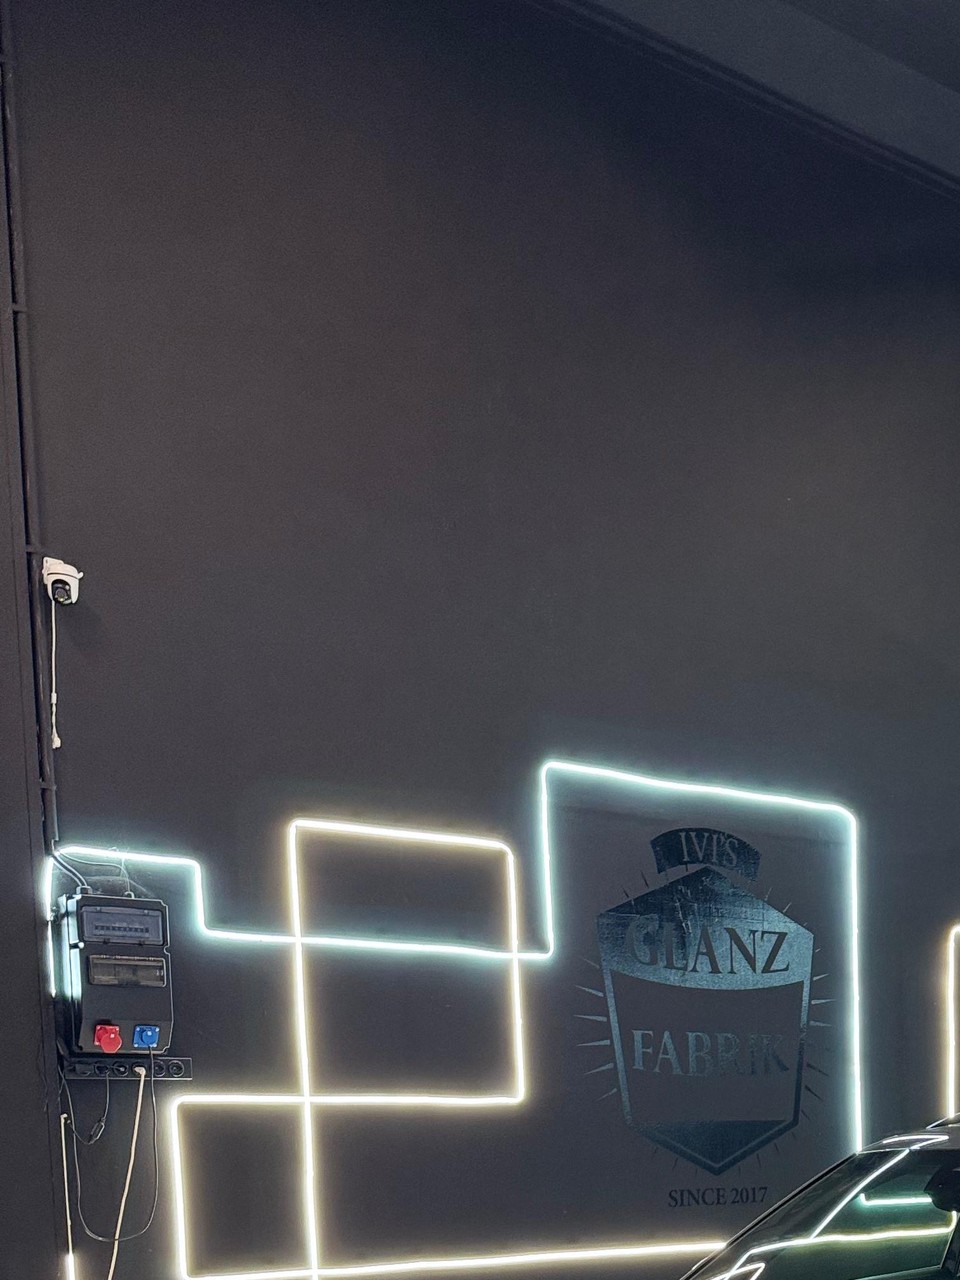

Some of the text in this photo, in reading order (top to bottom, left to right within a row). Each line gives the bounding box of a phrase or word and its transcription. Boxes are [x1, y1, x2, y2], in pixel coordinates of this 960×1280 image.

[625, 914, 790, 974] GLANZ
[631, 1029, 790, 1076] FABRIK
[668, 1186, 768, 1207] SINCE 2017
